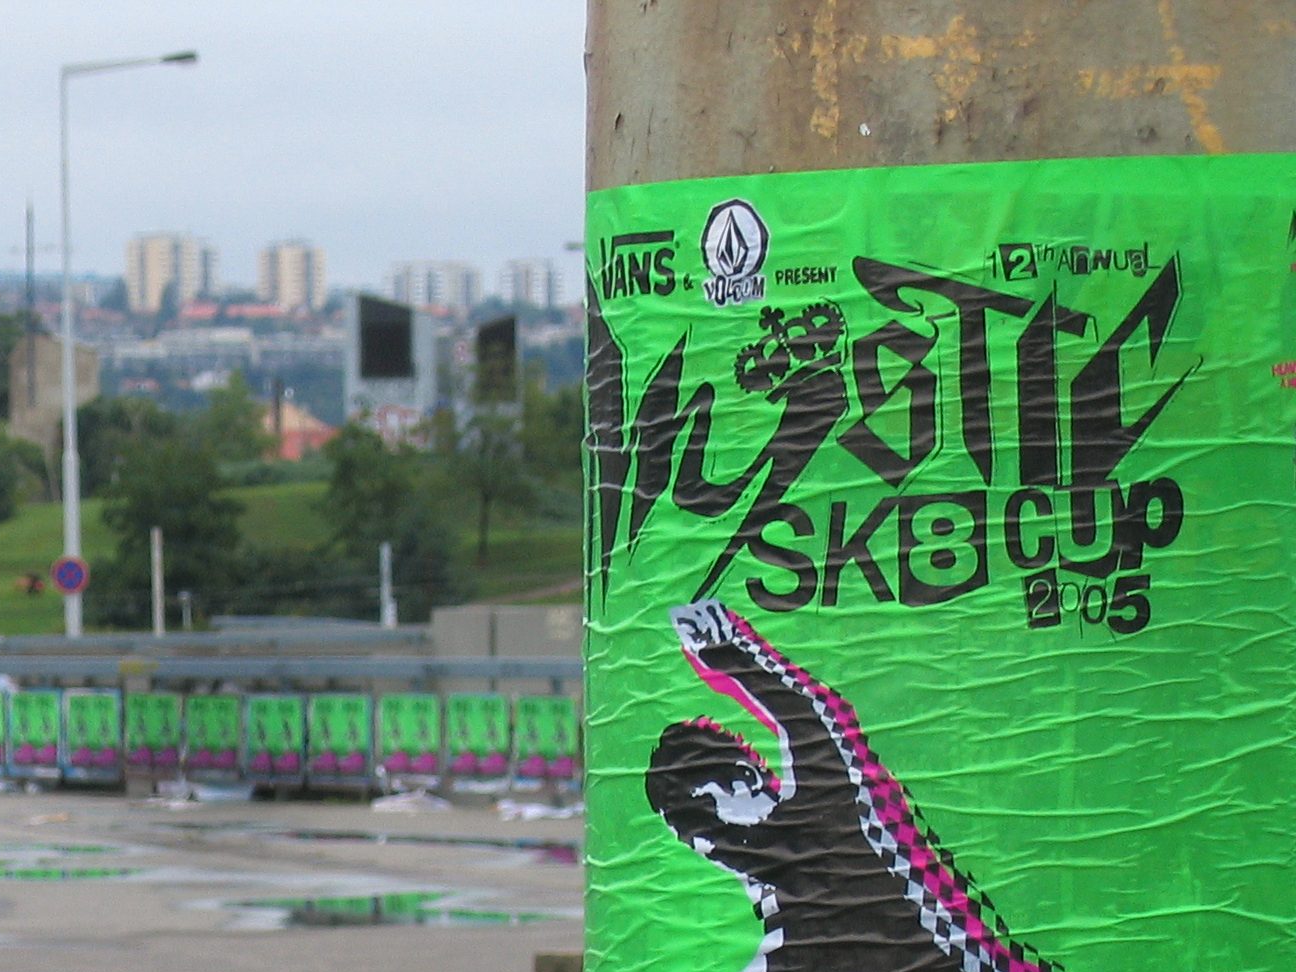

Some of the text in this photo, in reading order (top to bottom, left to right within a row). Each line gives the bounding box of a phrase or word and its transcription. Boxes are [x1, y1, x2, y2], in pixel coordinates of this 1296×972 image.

[600, 230, 838, 307] VANS & VOLCOM PRESENT
[744, 476, 1185, 612] SK8 CUP
[1025, 567, 1152, 636] 2005
